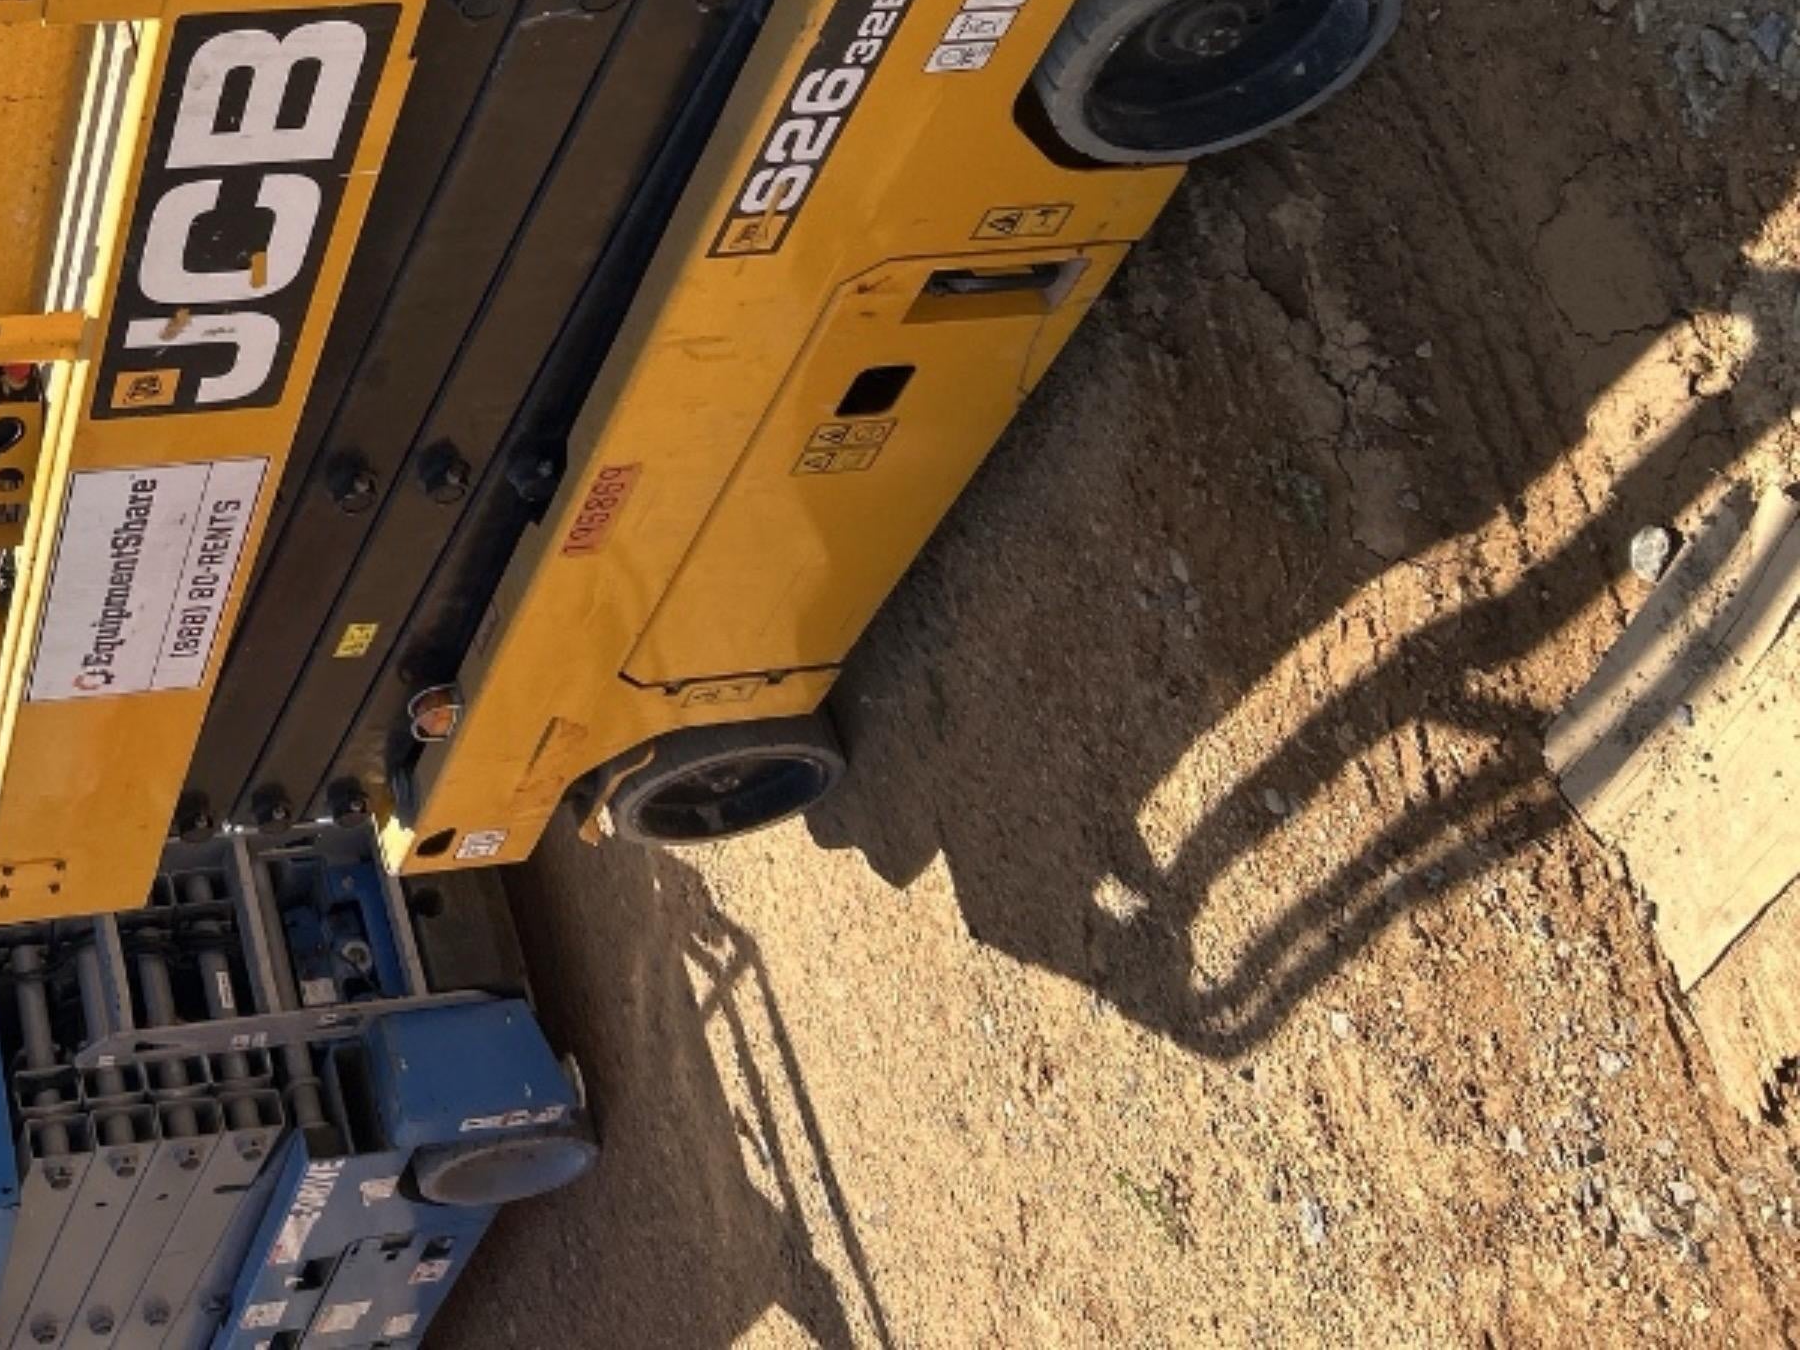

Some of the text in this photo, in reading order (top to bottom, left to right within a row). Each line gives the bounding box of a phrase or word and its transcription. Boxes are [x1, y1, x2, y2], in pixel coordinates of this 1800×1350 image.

[124, 19, 368, 403] JCB
[81, 479, 157, 667] EquipmentShare
[171, 500, 242, 659] (888) 80-RENTS
